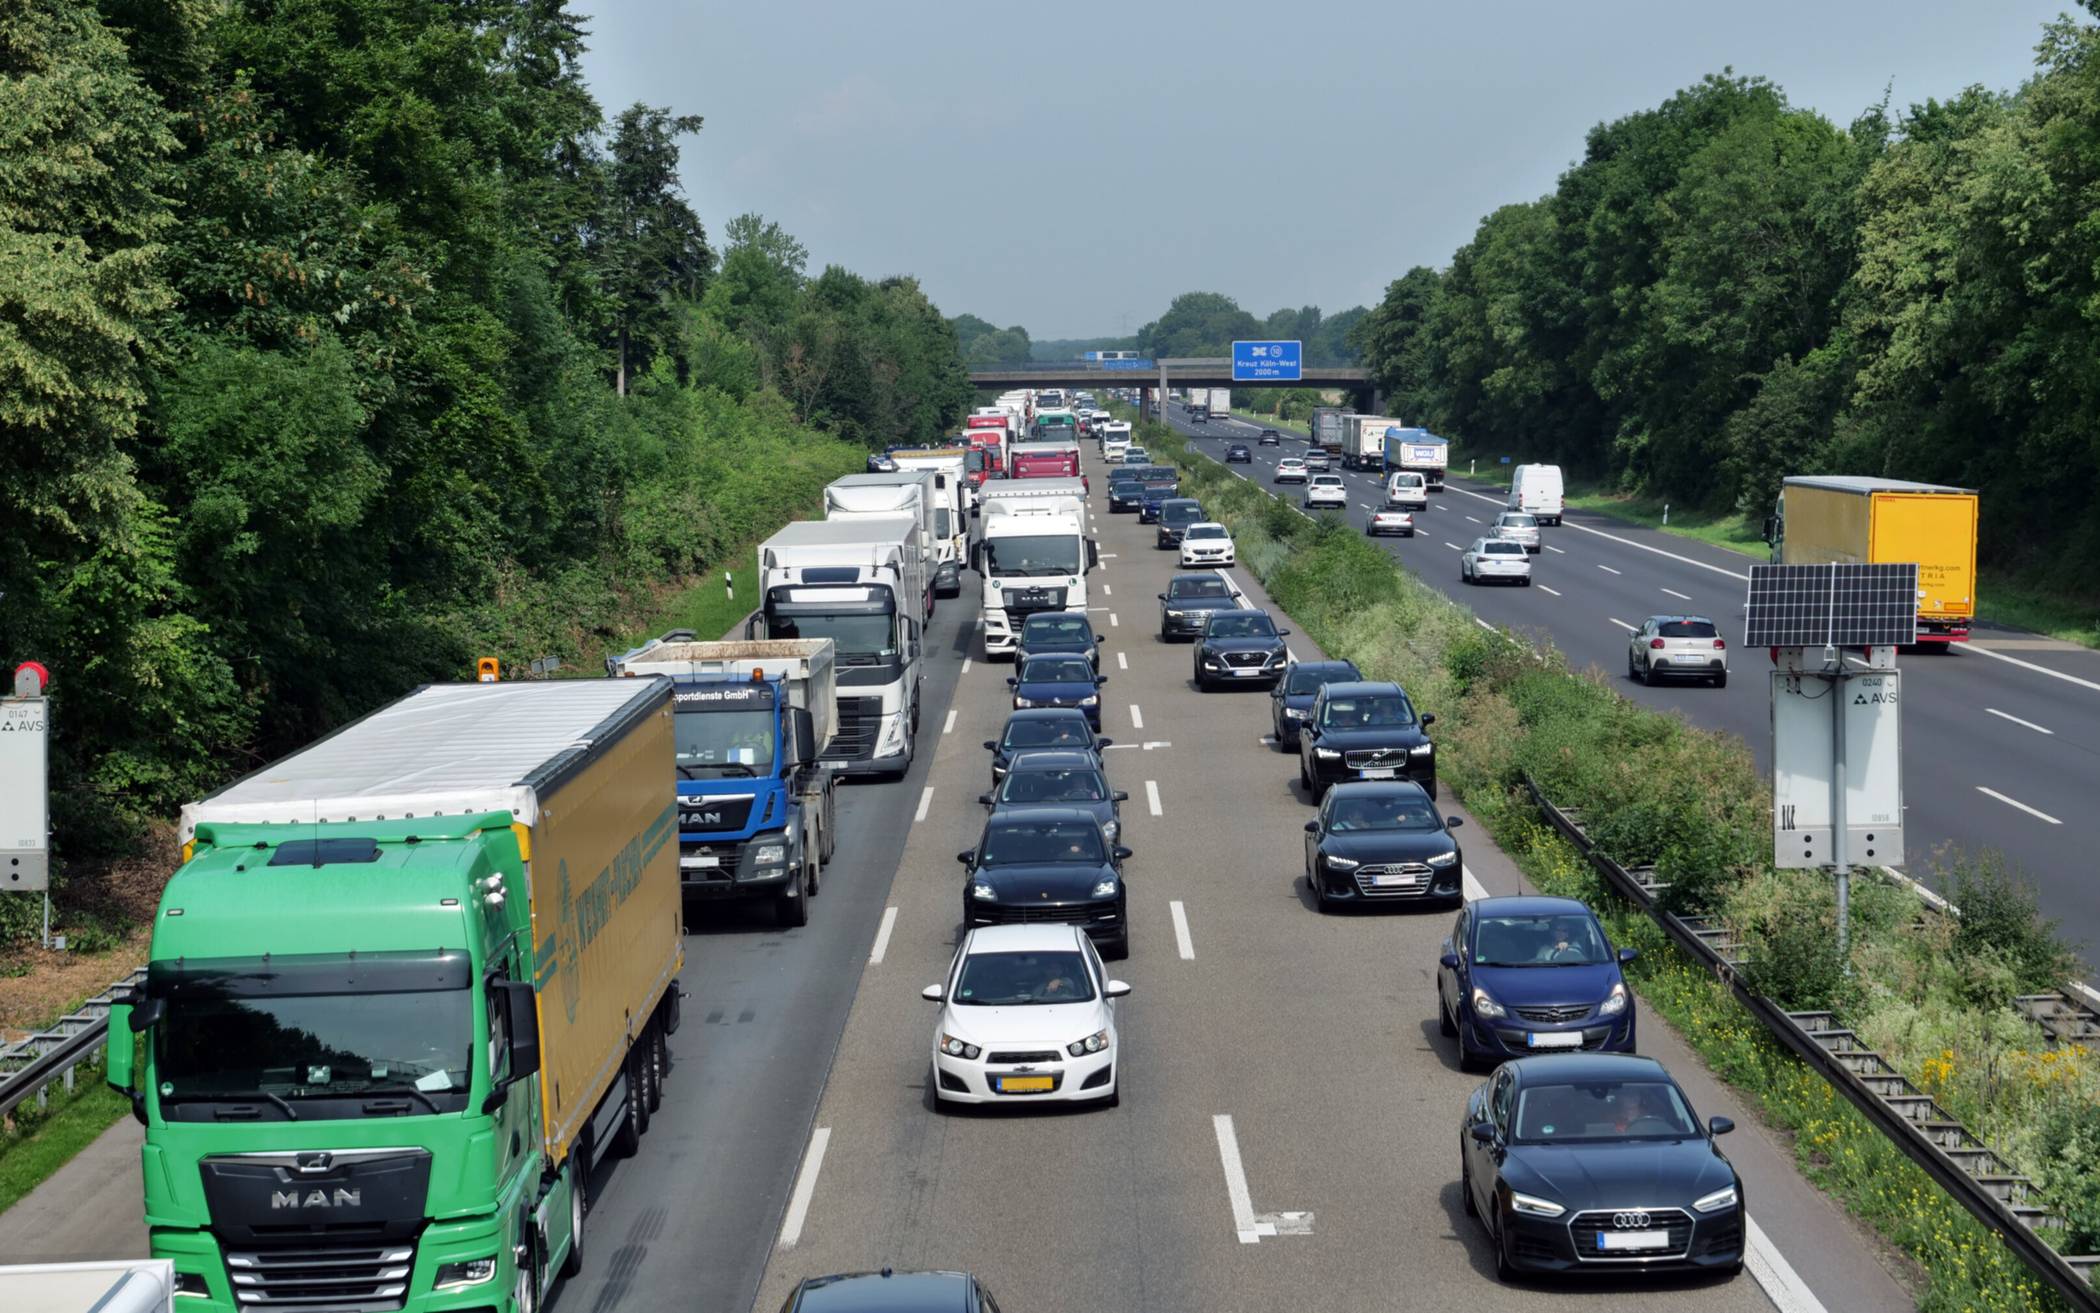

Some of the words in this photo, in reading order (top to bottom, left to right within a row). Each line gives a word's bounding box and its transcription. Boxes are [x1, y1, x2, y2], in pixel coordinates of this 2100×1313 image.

[1862, 678, 1881, 686] 0240
[724, 690, 749, 700] GmbH
[1871, 692, 1897, 704] AVS
[9, 710, 28, 719] 0147
[19, 720, 44, 731] AVS
[271, 1188, 361, 1209] MAN
